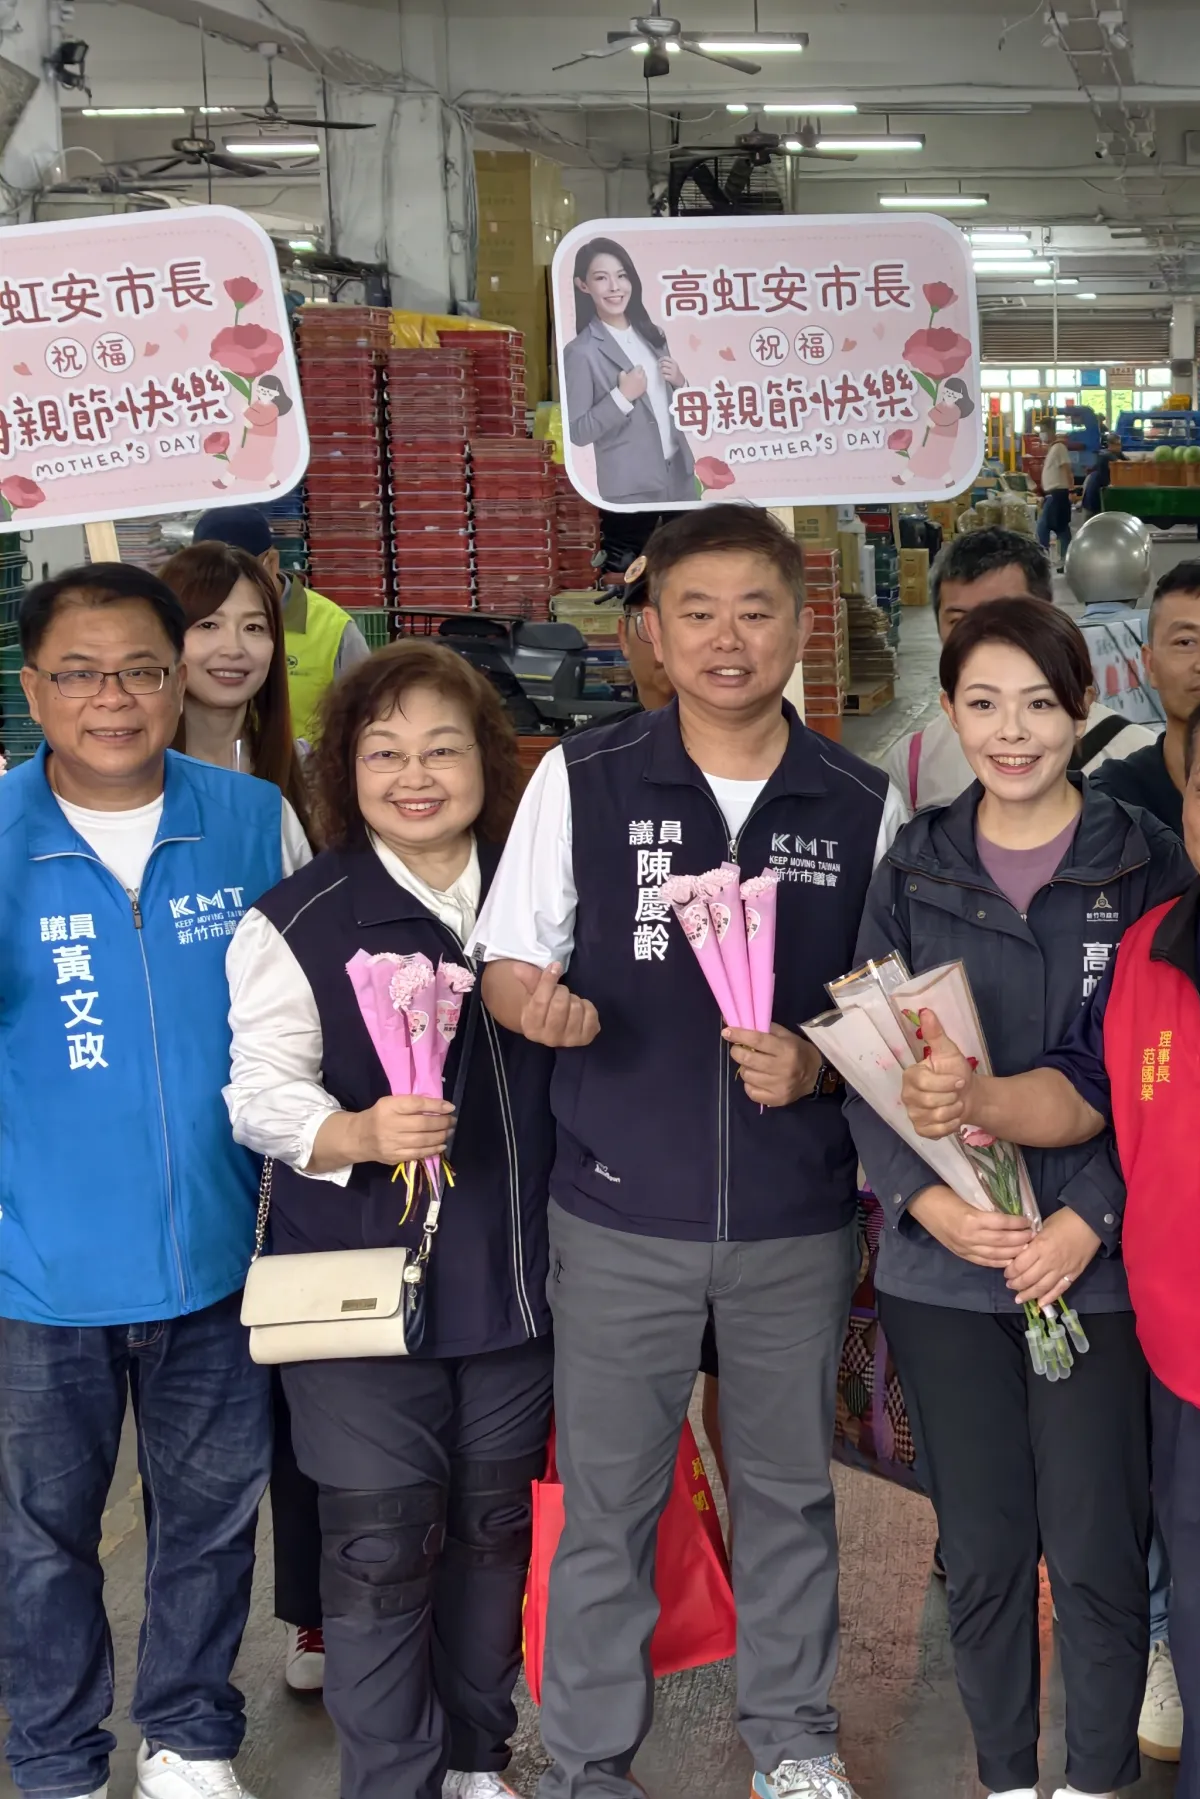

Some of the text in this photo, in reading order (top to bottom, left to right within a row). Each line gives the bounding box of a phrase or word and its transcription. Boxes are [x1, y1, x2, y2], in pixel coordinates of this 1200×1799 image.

[1, 261, 213, 326] 虹安市長
[661, 264, 911, 317] 高虹安市長
[51, 339, 127, 373] 祝福
[757, 333, 826, 361] 祝福
[673, 367, 915, 436] 母親節快樂
[36, 434, 197, 477] MOTHER'S DAY
[729, 430, 882, 459] MOTHER'S DAY
[629, 820, 683, 845] 議員
[771, 832, 839, 859] KMT
[769, 855, 841, 872] KEEP MOVING TAIWAN
[773, 866, 838, 887] 新竹市議會
[169, 887, 244, 919] KMT
[633, 848, 673, 961] 陳慶齡
[40, 913, 96, 942] 議員
[174, 918, 194, 929] KEEP
[197, 912, 225, 924] MOVING
[52, 944, 109, 1070] 黃文政
[1155, 1030, 1173, 1083] 理事長
[1140, 1048, 1156, 1101] 范國榮
